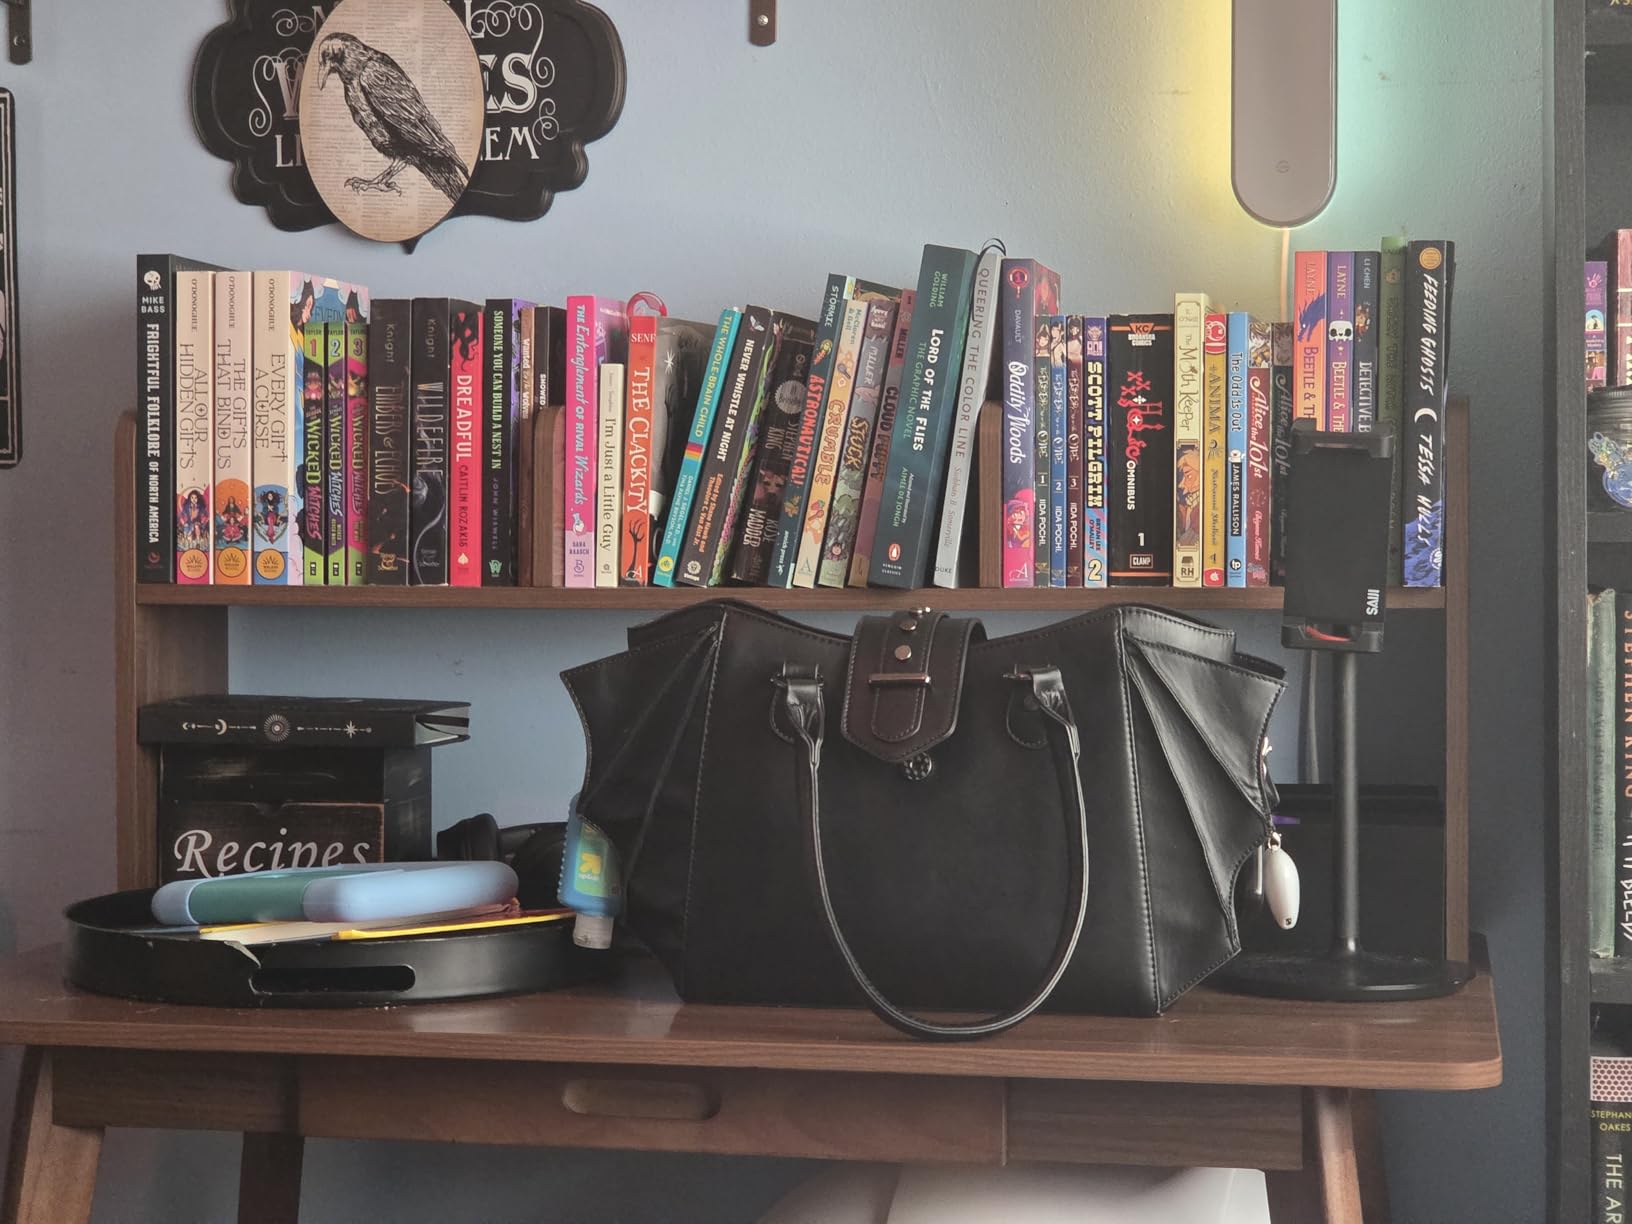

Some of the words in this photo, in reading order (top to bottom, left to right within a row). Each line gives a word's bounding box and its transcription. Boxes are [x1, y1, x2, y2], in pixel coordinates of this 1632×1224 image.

[142, 295, 165, 305] MIKE
[930, 270, 942, 308] GOLDING
[936, 273, 949, 307] WILLIAM
[1337, 265, 1346, 299] LAYNE
[141, 305, 166, 314] BASS
[576, 304, 586, 322] THE
[823, 285, 840, 328] STORMIE
[971, 267, 991, 338] QUEERING
[1423, 273, 1438, 335] FEEDING
[384, 323, 396, 363] Knight
[424, 318, 437, 358] Knight
[492, 310, 504, 351] SOMEONE
[722, 316, 733, 334] THE
[895, 328, 909, 360] MILLER
[1014, 310, 1022, 344] DAVAULT
[1135, 325, 1150, 333] KC
[146, 323, 160, 392] FRIGHTFUL
[217, 338, 231, 390] THAT
[310, 338, 317, 357] 1
[331, 338, 341, 357] 2
[353, 338, 363, 356] 3
[493, 354, 504, 371] YOU
[522, 338, 532, 369] Wanted
[570, 325, 590, 403] Entanglement
[739, 339, 755, 370] NEVER
[863, 345, 880, 384] MILLER
[916, 342, 927, 358] THE
[927, 329, 944, 363] LORD
[967, 344, 980, 371] THE
[1231, 352, 1243, 371] The
[179, 343, 195, 413] HIDDEN
[194, 368, 208, 401] ALL
[233, 358, 247, 391] THE
[255, 367, 269, 380] A
[271, 353, 286, 416] EVERY
[493, 373, 504, 391] CAN
[703, 337, 727, 404] WHOLE-BRAIN
[909, 362, 923, 403] GRAPHIC
[923, 368, 936, 386] OF
[1006, 361, 1030, 409] Oddity
[1231, 375, 1243, 396] Odd
[1303, 347, 1319, 389] BEETLE
[1332, 361, 1347, 402] BEETLE
[1419, 337, 1438, 397] GHOSTS
[493, 393, 503, 420] BUILD
[632, 366, 651, 412] THE
[728, 372, 747, 415] WHISTLE
[919, 390, 931, 411] THE
[960, 377, 976, 425] COLOR
[1086, 361, 1103, 420] SCOTT
[1250, 376, 1269, 429] Alice
[1275, 374, 1292, 427] Alice
[1303, 390, 1316, 400] &
[1333, 402, 1346, 410] &
[1359, 361, 1373, 421] DETECTIVE
[146, 396, 160, 457] FOLKLORE
[194, 403, 208, 442] OUR
[217, 396, 231, 440] BIND
[233, 397, 248, 449] GIFTS
[255, 384, 270, 449] CURSE
[375, 385, 402, 434] EMBERS
[456, 374, 473, 463] DREADFUL
[576, 405, 585, 420] OF
[604, 417, 617, 437] I'm
[694, 407, 708, 437] CHILD
[725, 417, 735, 429] AT
[879, 385, 900, 432] CLOUD
[903, 406, 916, 439] NOVEL
[1178, 391, 1200, 431] Keeper
[1231, 412, 1243, 432] Out
[179, 417, 197, 470] GIFTS
[271, 420, 288, 463] GIFT
[329, 415, 343, 470] WICKED
[352, 415, 366, 470] WICKED
[416, 382, 443, 476] WILDEFIRE
[492, 432, 502, 456] NEST
[575, 423, 585, 452] RIVAL
[717, 431, 732, 461] NIGHT
[765, 427, 785, 450] KING
[781, 422, 800, 460] STEPHEN
[791, 374, 825, 486] ASTRONAUTICAL!
[815, 400, 846, 485] CRUMBLE
[844, 416, 871, 470] STUCK
[912, 416, 928, 451] FLIES
[955, 428, 969, 459] LINE
[1008, 409, 1032, 465] Woods
[148, 461, 159, 471] OF
[217, 446, 231, 469] US
[305, 418, 322, 485] WICKED
[492, 459, 502, 470] IN
[604, 441, 616, 470] Just
[626, 416, 650, 516] CLACKITY
[1087, 424, 1104, 508] PILGRIM
[1417, 434, 1436, 486] TESSA
[148, 474, 159, 502] NORTH
[374, 451, 402, 495] ECHOES
[459, 464, 469, 502] CAITLIN
[575, 455, 591, 505] Wizards
[1126, 460, 1137, 510] OMNIBUS
[1232, 464, 1241, 492] JAMES
[305, 486, 322, 540] WITCHES
[329, 471, 344, 517] WITCHES
[603, 485, 616, 520] Little
[148, 505, 159, 543] AMERICA
[459, 506, 469, 547] ROZAKIS
[742, 508, 766, 548] MADDER
[892, 501, 904, 527] JONGH
[1232, 494, 1241, 535] RALLISON
[1417, 494, 1433, 547] HULLS
[601, 523, 614, 551] Guy
[1138, 532, 1145, 546] 1
[1088, 560, 1103, 581] 2
[1180, 567, 1195, 577] RH
[1599, 1122, 1631, 1132] OAKES
[1605, 1154, 1623, 1188] THE
